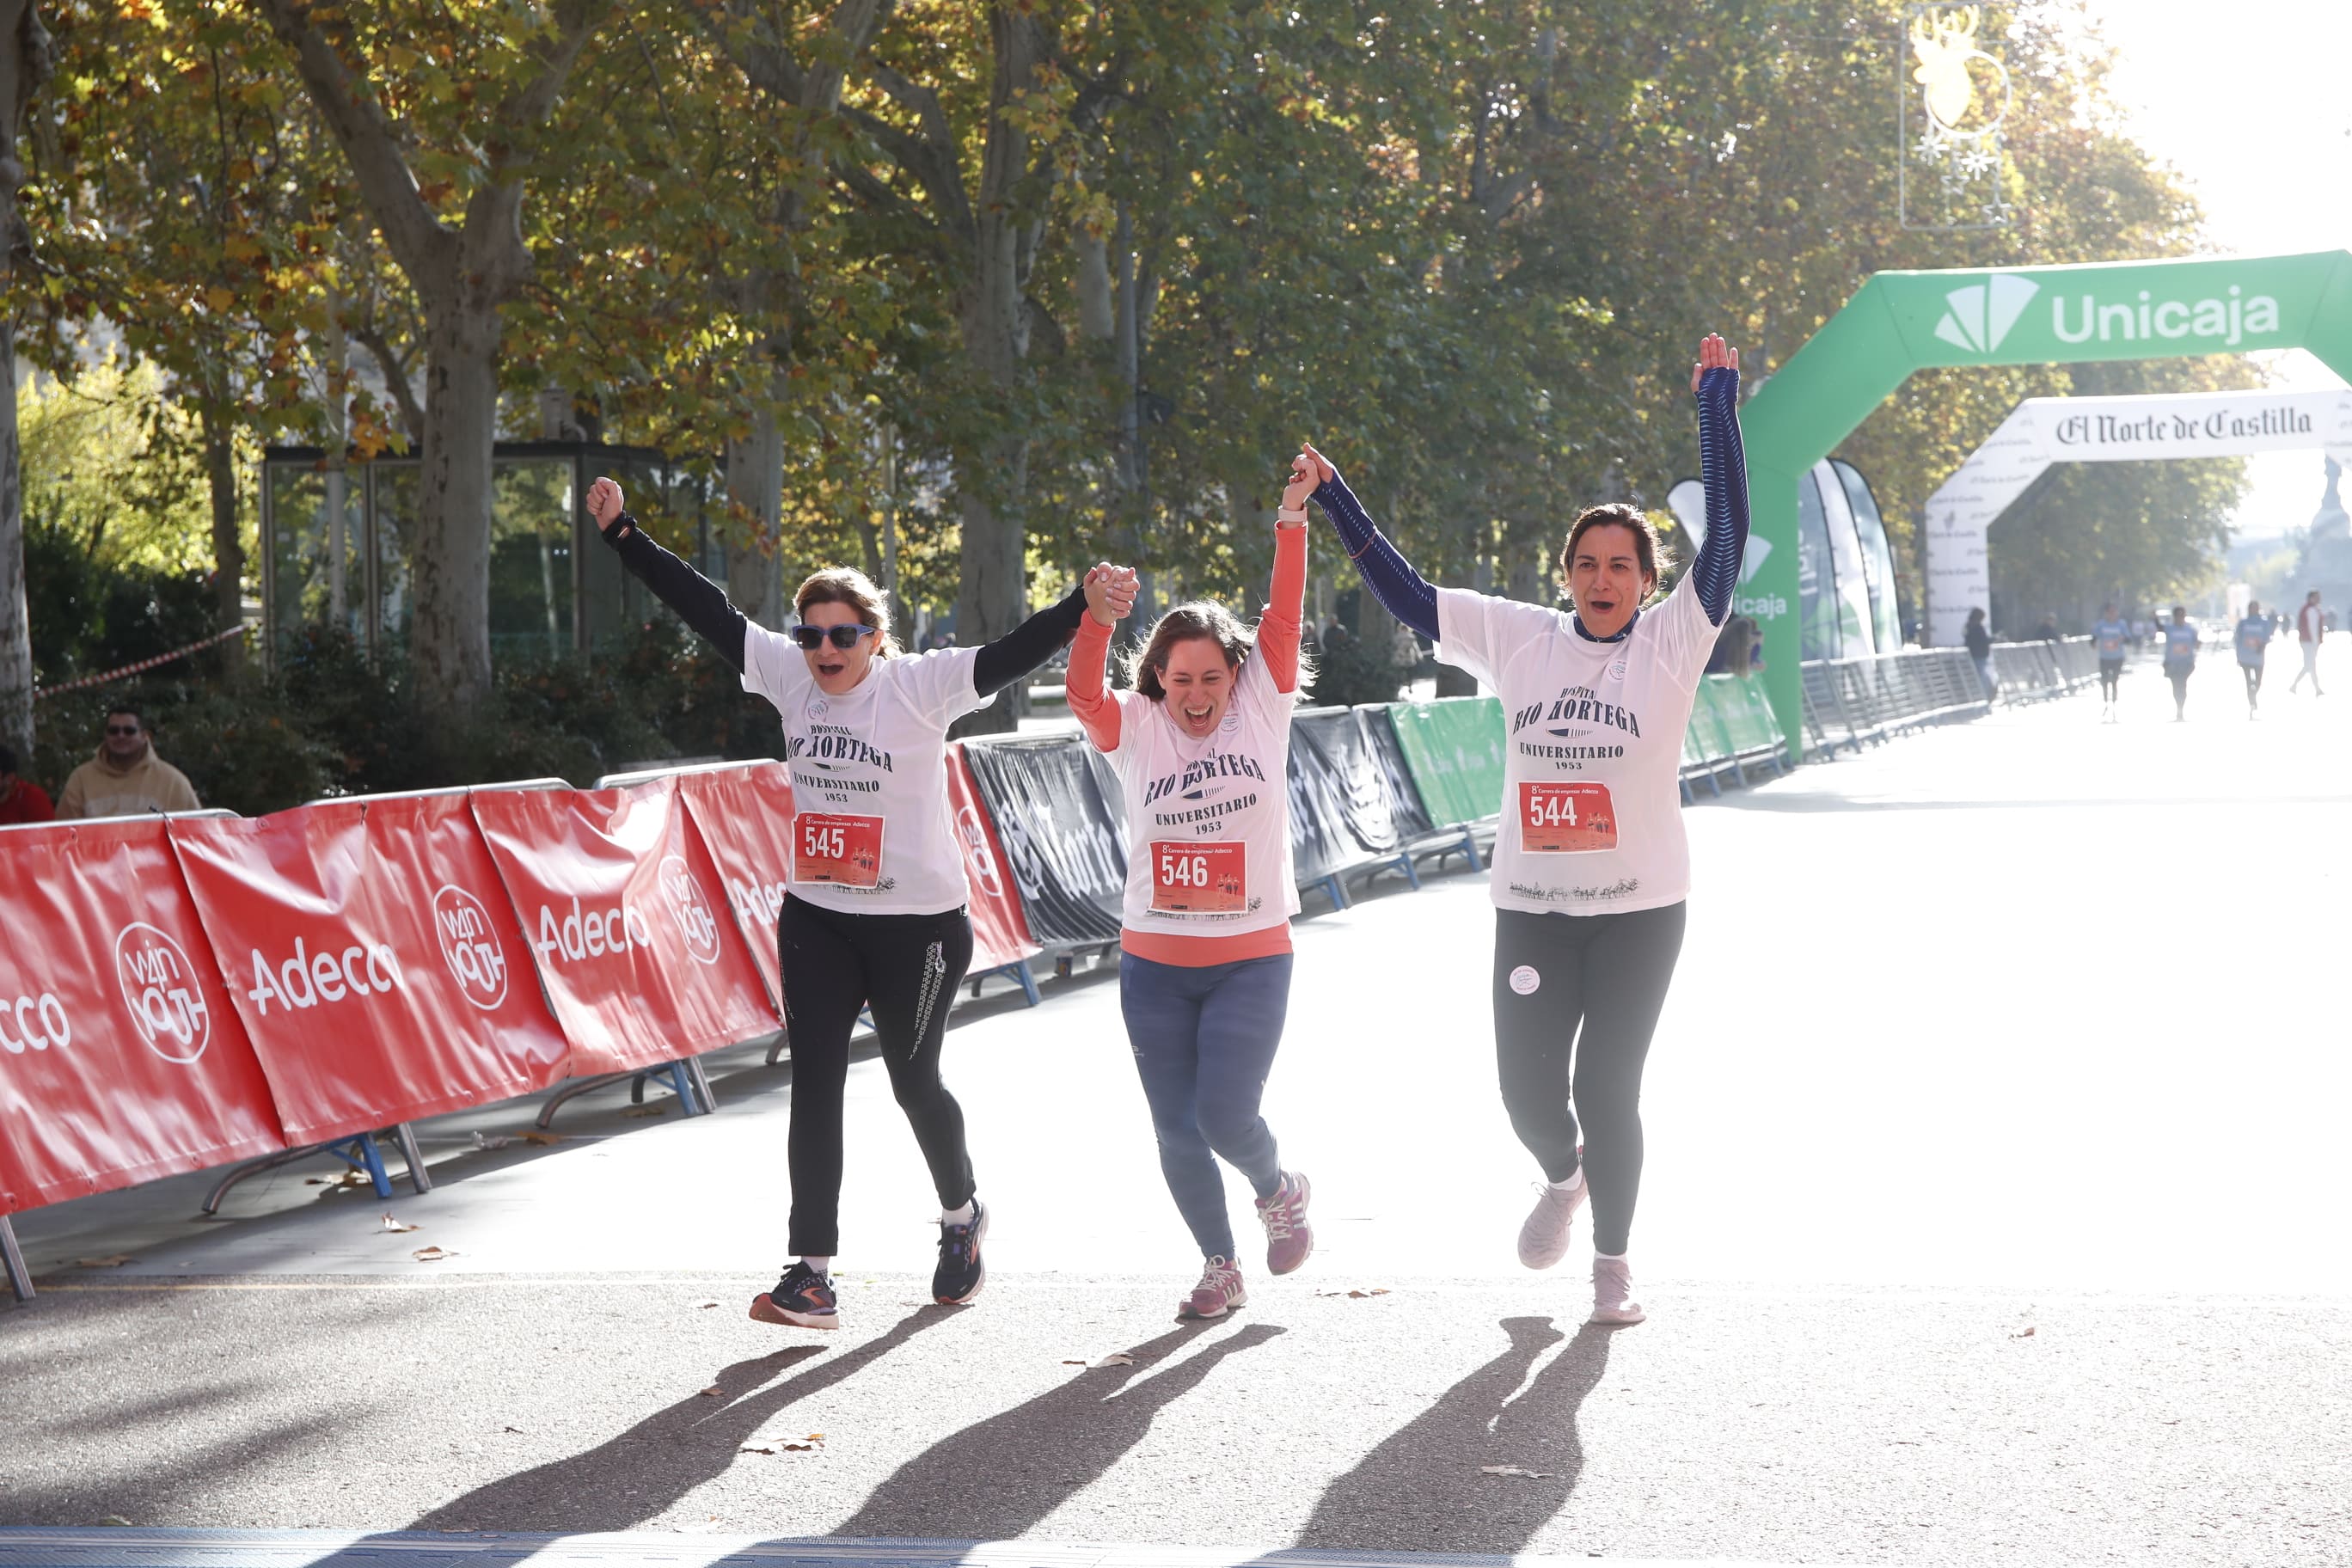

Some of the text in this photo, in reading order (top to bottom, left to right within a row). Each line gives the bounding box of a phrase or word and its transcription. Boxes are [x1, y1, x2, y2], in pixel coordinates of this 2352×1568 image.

[2052, 285, 2279, 346] Unicaja
[2056, 406, 2313, 446] El Norte de Castilla
[1734, 592, 1786, 621] icaja
[1513, 698, 1641, 739] RIO HORTEGA
[1520, 741, 1624, 759] UNIVERSITARIO
[1555, 762, 1583, 770] 1953
[793, 770, 880, 793] UNIVERSITARIO
[824, 792, 848, 803] 1953
[1143, 774, 1176, 808] RIO
[1155, 793, 1258, 826] UNIVERSITARIO
[1530, 796, 1577, 827] 544
[805, 826, 845, 859] 545
[1196, 821, 1222, 836] 1953
[1161, 855, 1208, 887] 546
[0, 992, 70, 1054] cco
